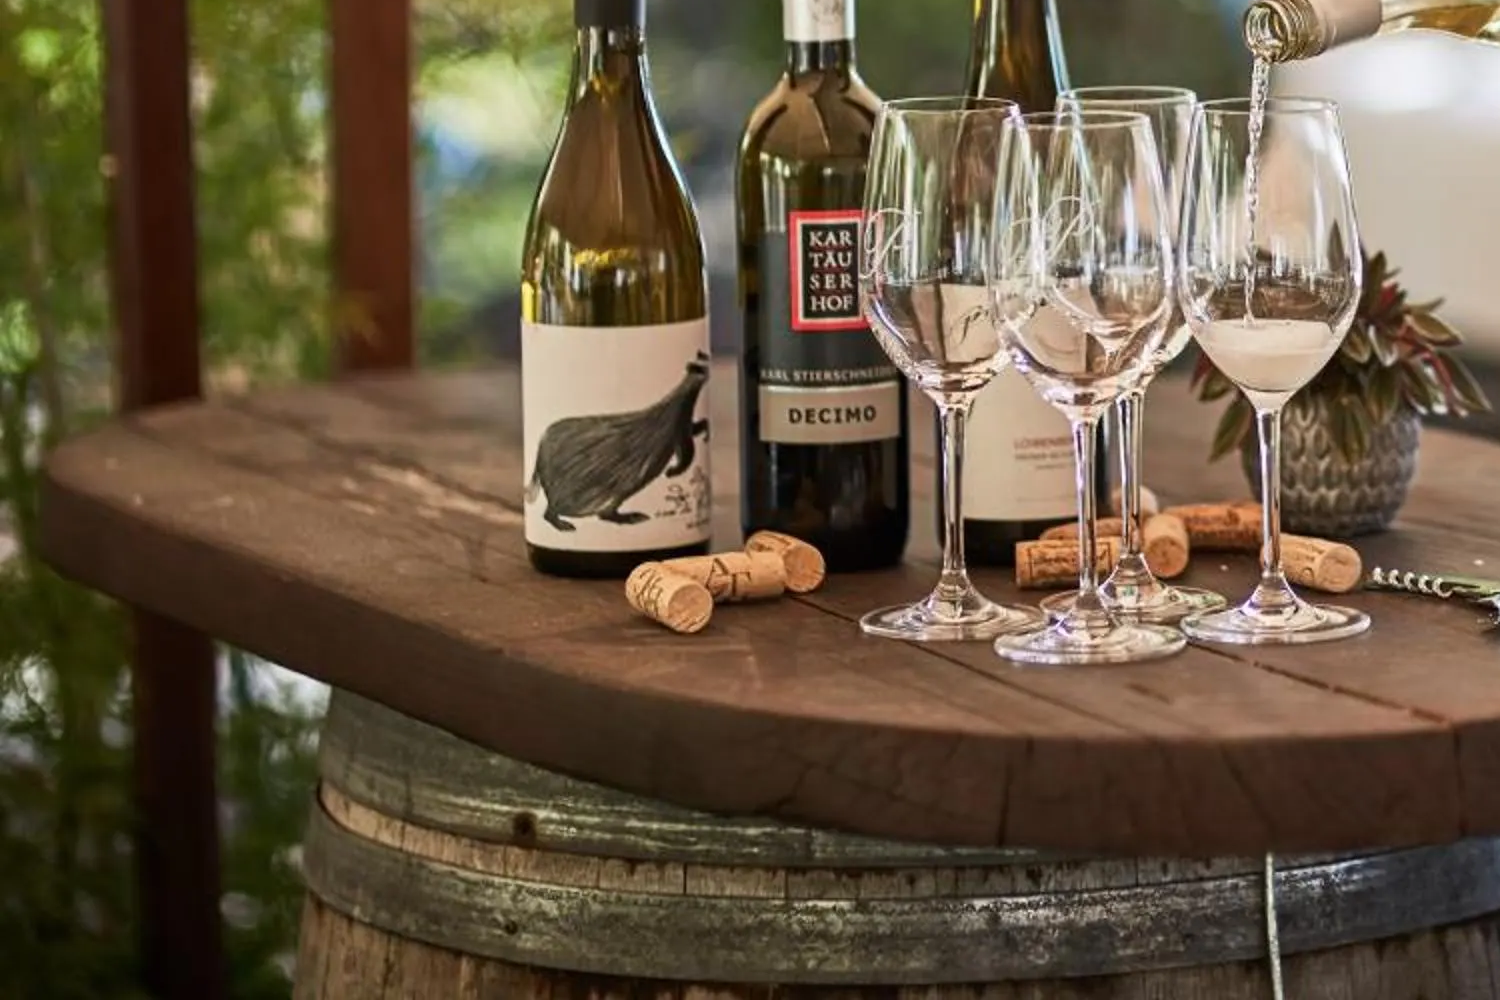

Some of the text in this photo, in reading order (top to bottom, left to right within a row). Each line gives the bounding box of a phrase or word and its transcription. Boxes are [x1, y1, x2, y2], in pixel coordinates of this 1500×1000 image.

[809, 231, 853, 247] KAR
[809, 273, 854, 290] SER
[810, 295, 853, 312] HOF
[788, 404, 877, 425] DECIMO
